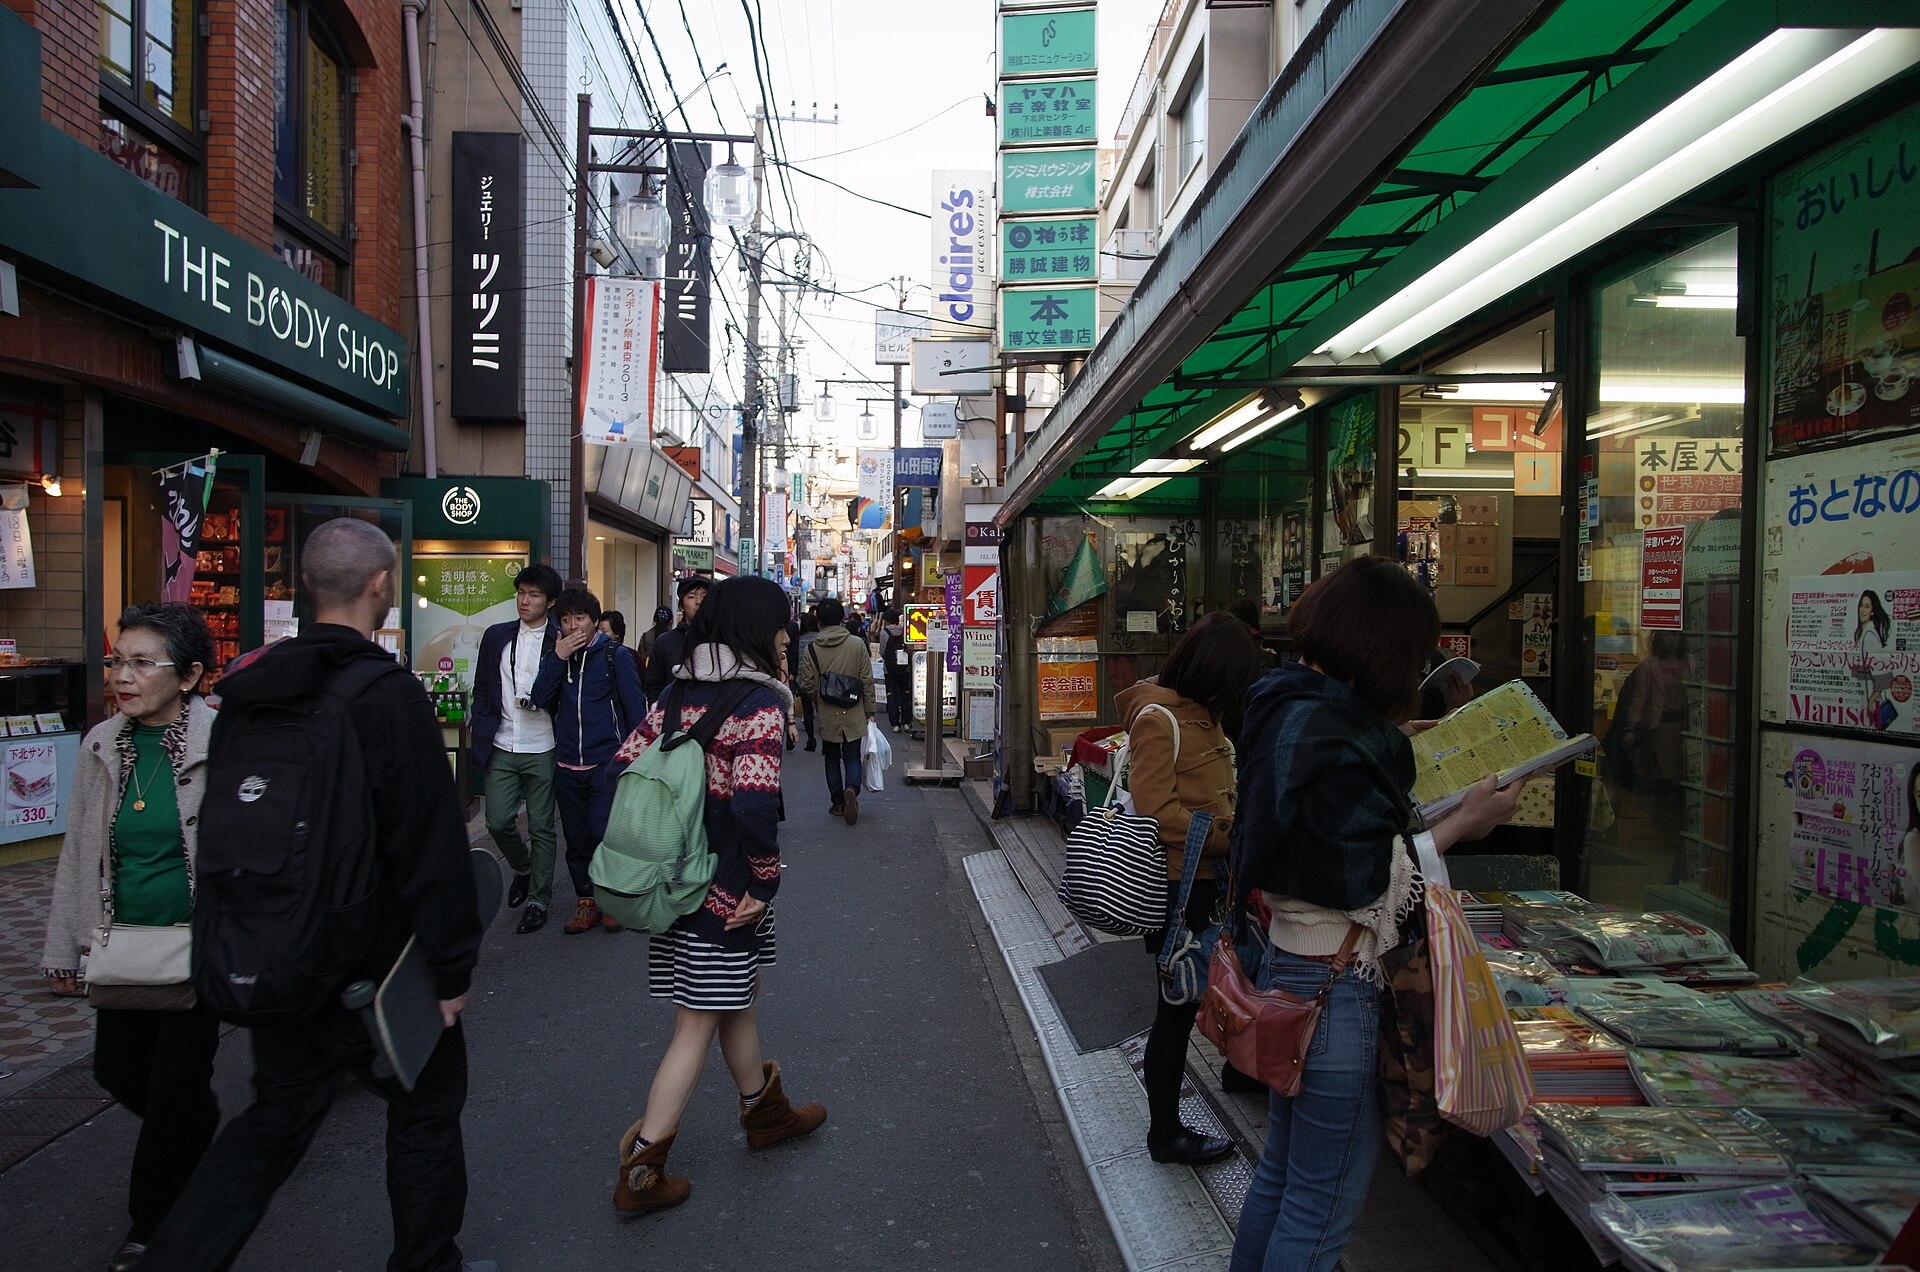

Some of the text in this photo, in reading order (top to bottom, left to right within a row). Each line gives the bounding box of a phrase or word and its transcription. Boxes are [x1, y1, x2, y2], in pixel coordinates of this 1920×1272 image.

[1022, 86, 1077, 100] ヤマハ
[1007, 98, 1091, 114] 音楽教室
[1022, 113, 1077, 123] 下北沢センター
[1075, 124, 1092, 135] 4F
[1006, 160, 1093, 180] フジミハウジング
[1024, 183, 1075, 200] 株式会社
[480, 175, 494, 241] ジュエリー
[977, 188, 986, 274] accessories
[938, 187, 975, 323] claire's
[1009, 254, 1091, 275] 勝誠建物
[678, 243, 697, 321] ツツミ
[153, 219, 232, 314] THE
[247, 271, 332, 360] BODY
[337, 322, 399, 391] SHOP
[471, 252, 501, 371] ツツミ
[1029, 294, 1070, 326] 本
[620, 287, 636, 402] スポーツ祭東京2013
[1008, 327, 1092, 346] 博文堂書店
[1397, 427, 1459, 465] 2F
[677, 458, 697, 468] Café
[1788, 469, 1920, 526] おとなの
[451, 510, 473, 518] SHOP
[1467, 536, 1489, 545] 語学
[1645, 535, 1683, 548] 洋書バーゲン
[1691, 545, 1706, 553] My
[440, 570, 495, 583] 透明感を、
[1464, 565, 1490, 575] 児童書
[441, 584, 488, 595] 実感せよ
[976, 590, 995, 609] 賃
[964, 631, 993, 640] Wine
[1524, 633, 1550, 643] NEW
[1041, 677, 1085, 692] 英会話
[1790, 692, 1883, 732] Marisol
[9, 744, 54, 761] 下北サンド
[1826, 767, 1856, 785] お弁当
[1826, 781, 1855, 799] BOOK
[1869, 763, 1881, 888] おしゃれ女子力を
[1815, 847, 1872, 906] LEE
